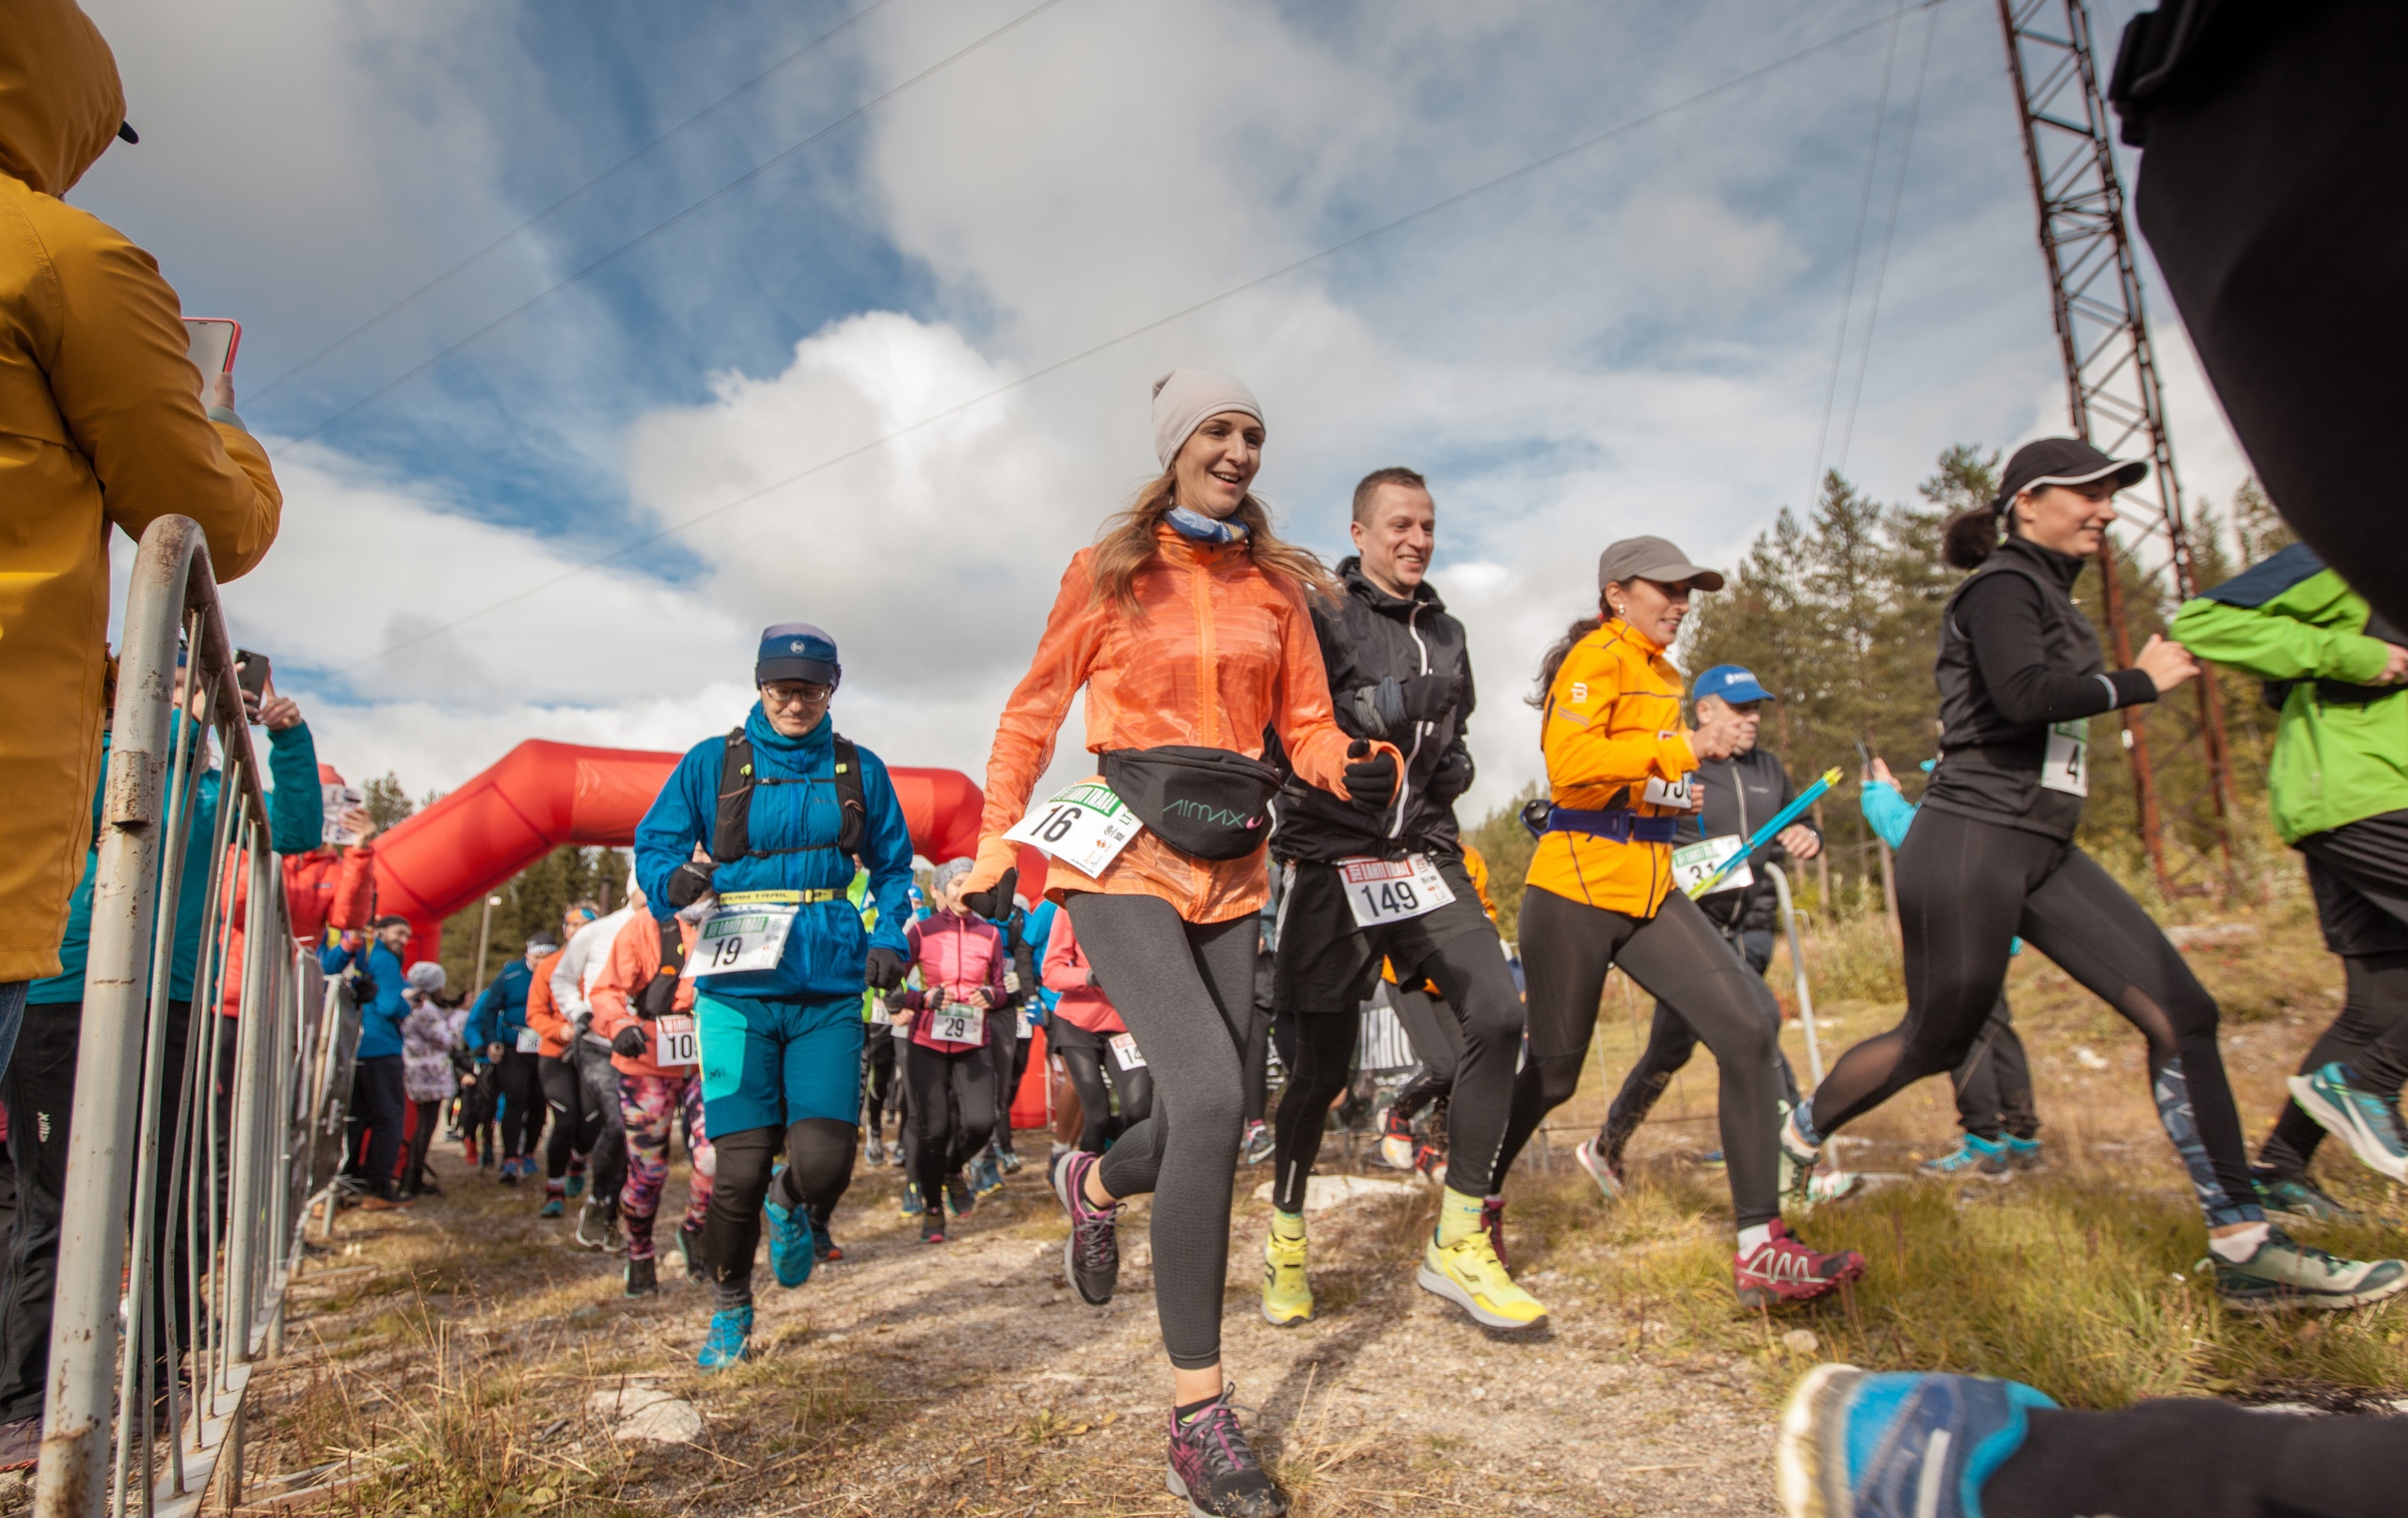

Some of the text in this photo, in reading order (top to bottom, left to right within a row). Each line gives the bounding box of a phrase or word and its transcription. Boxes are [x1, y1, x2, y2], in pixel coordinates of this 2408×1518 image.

[1030, 805, 1082, 843] 16
[1361, 881, 1419, 917] 149
[711, 936, 743, 968] 19
[944, 1018, 965, 1038] 29
[669, 1034, 698, 1060] 10
